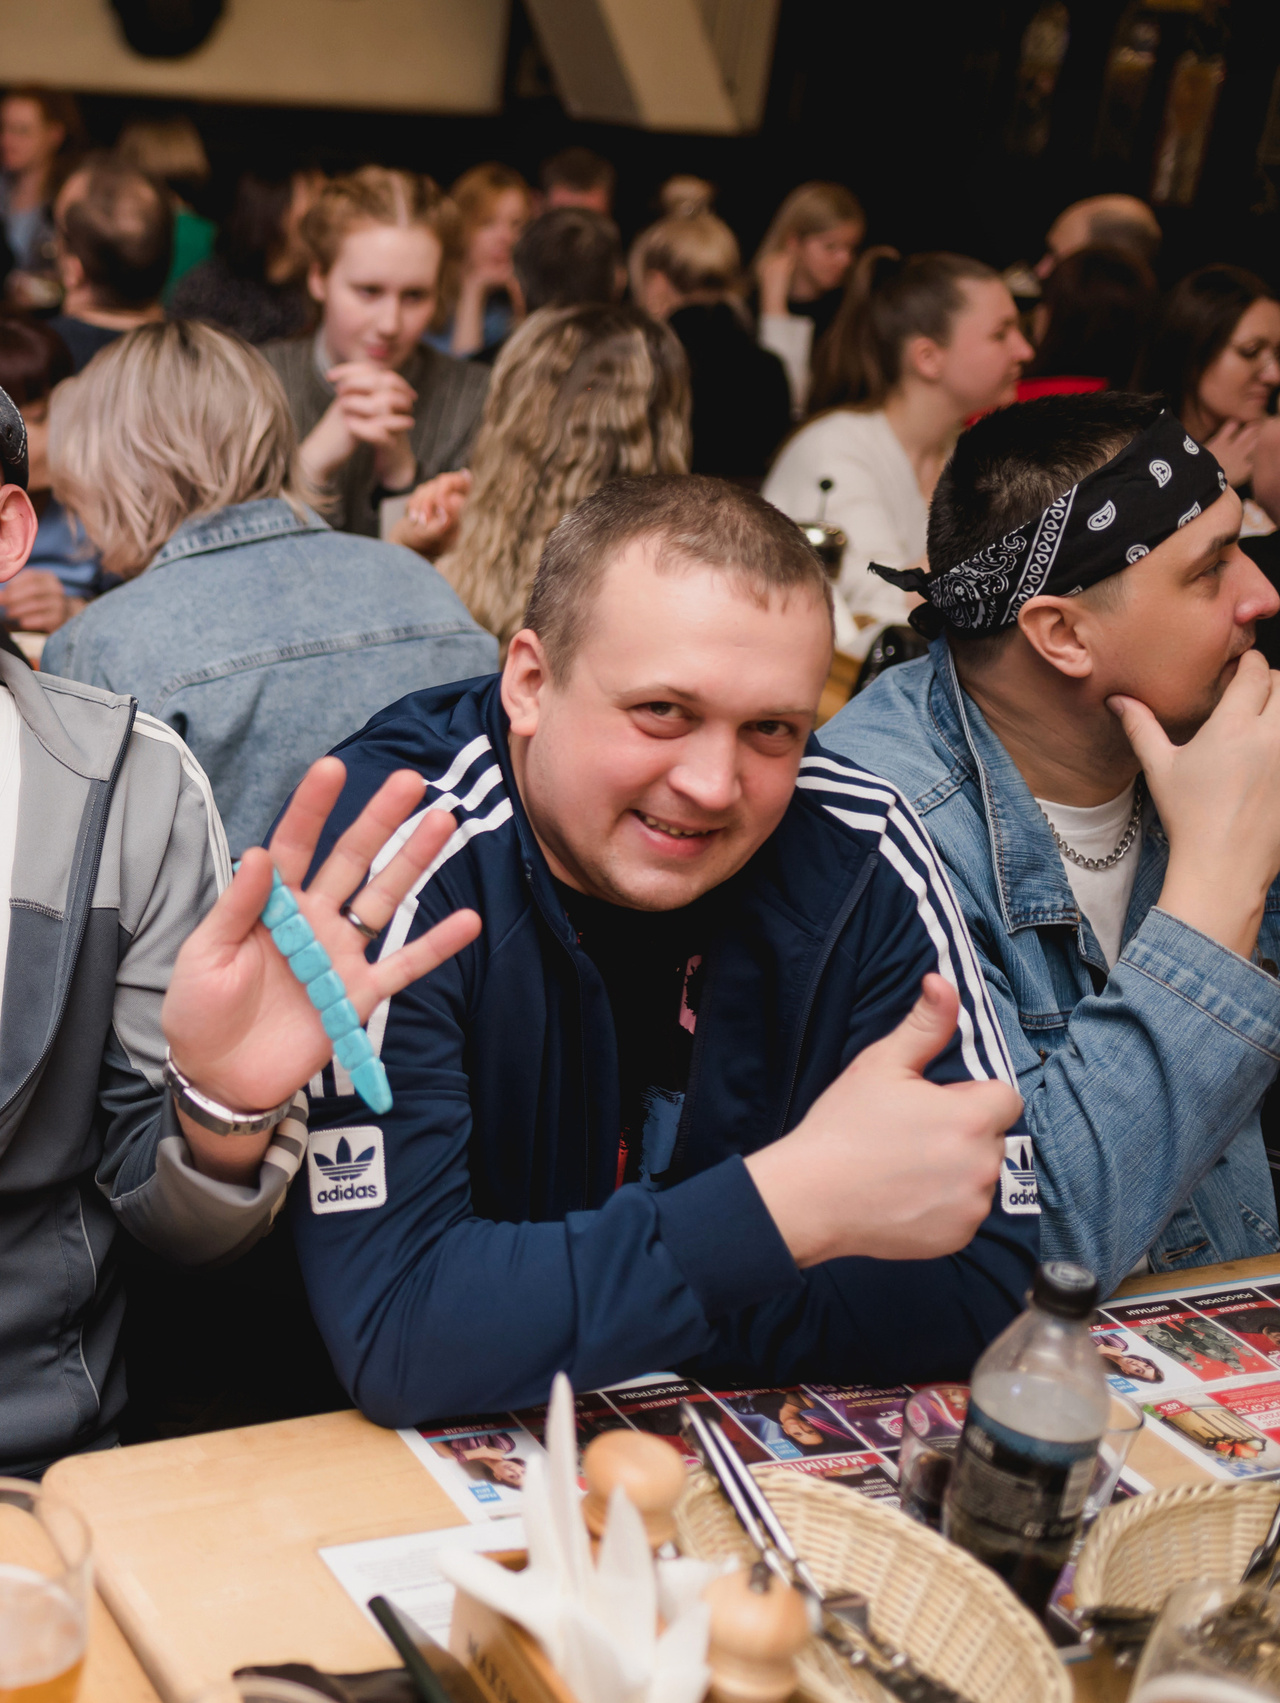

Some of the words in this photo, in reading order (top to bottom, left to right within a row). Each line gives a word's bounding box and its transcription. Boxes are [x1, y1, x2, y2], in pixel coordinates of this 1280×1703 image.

[317, 1183, 378, 1204] adidas
[1009, 1189, 1040, 1205] adid
[618, 1384, 690, 1400] РОК-ОСТРОВА
[639, 1398, 678, 1410] АПРЕЛЯ
